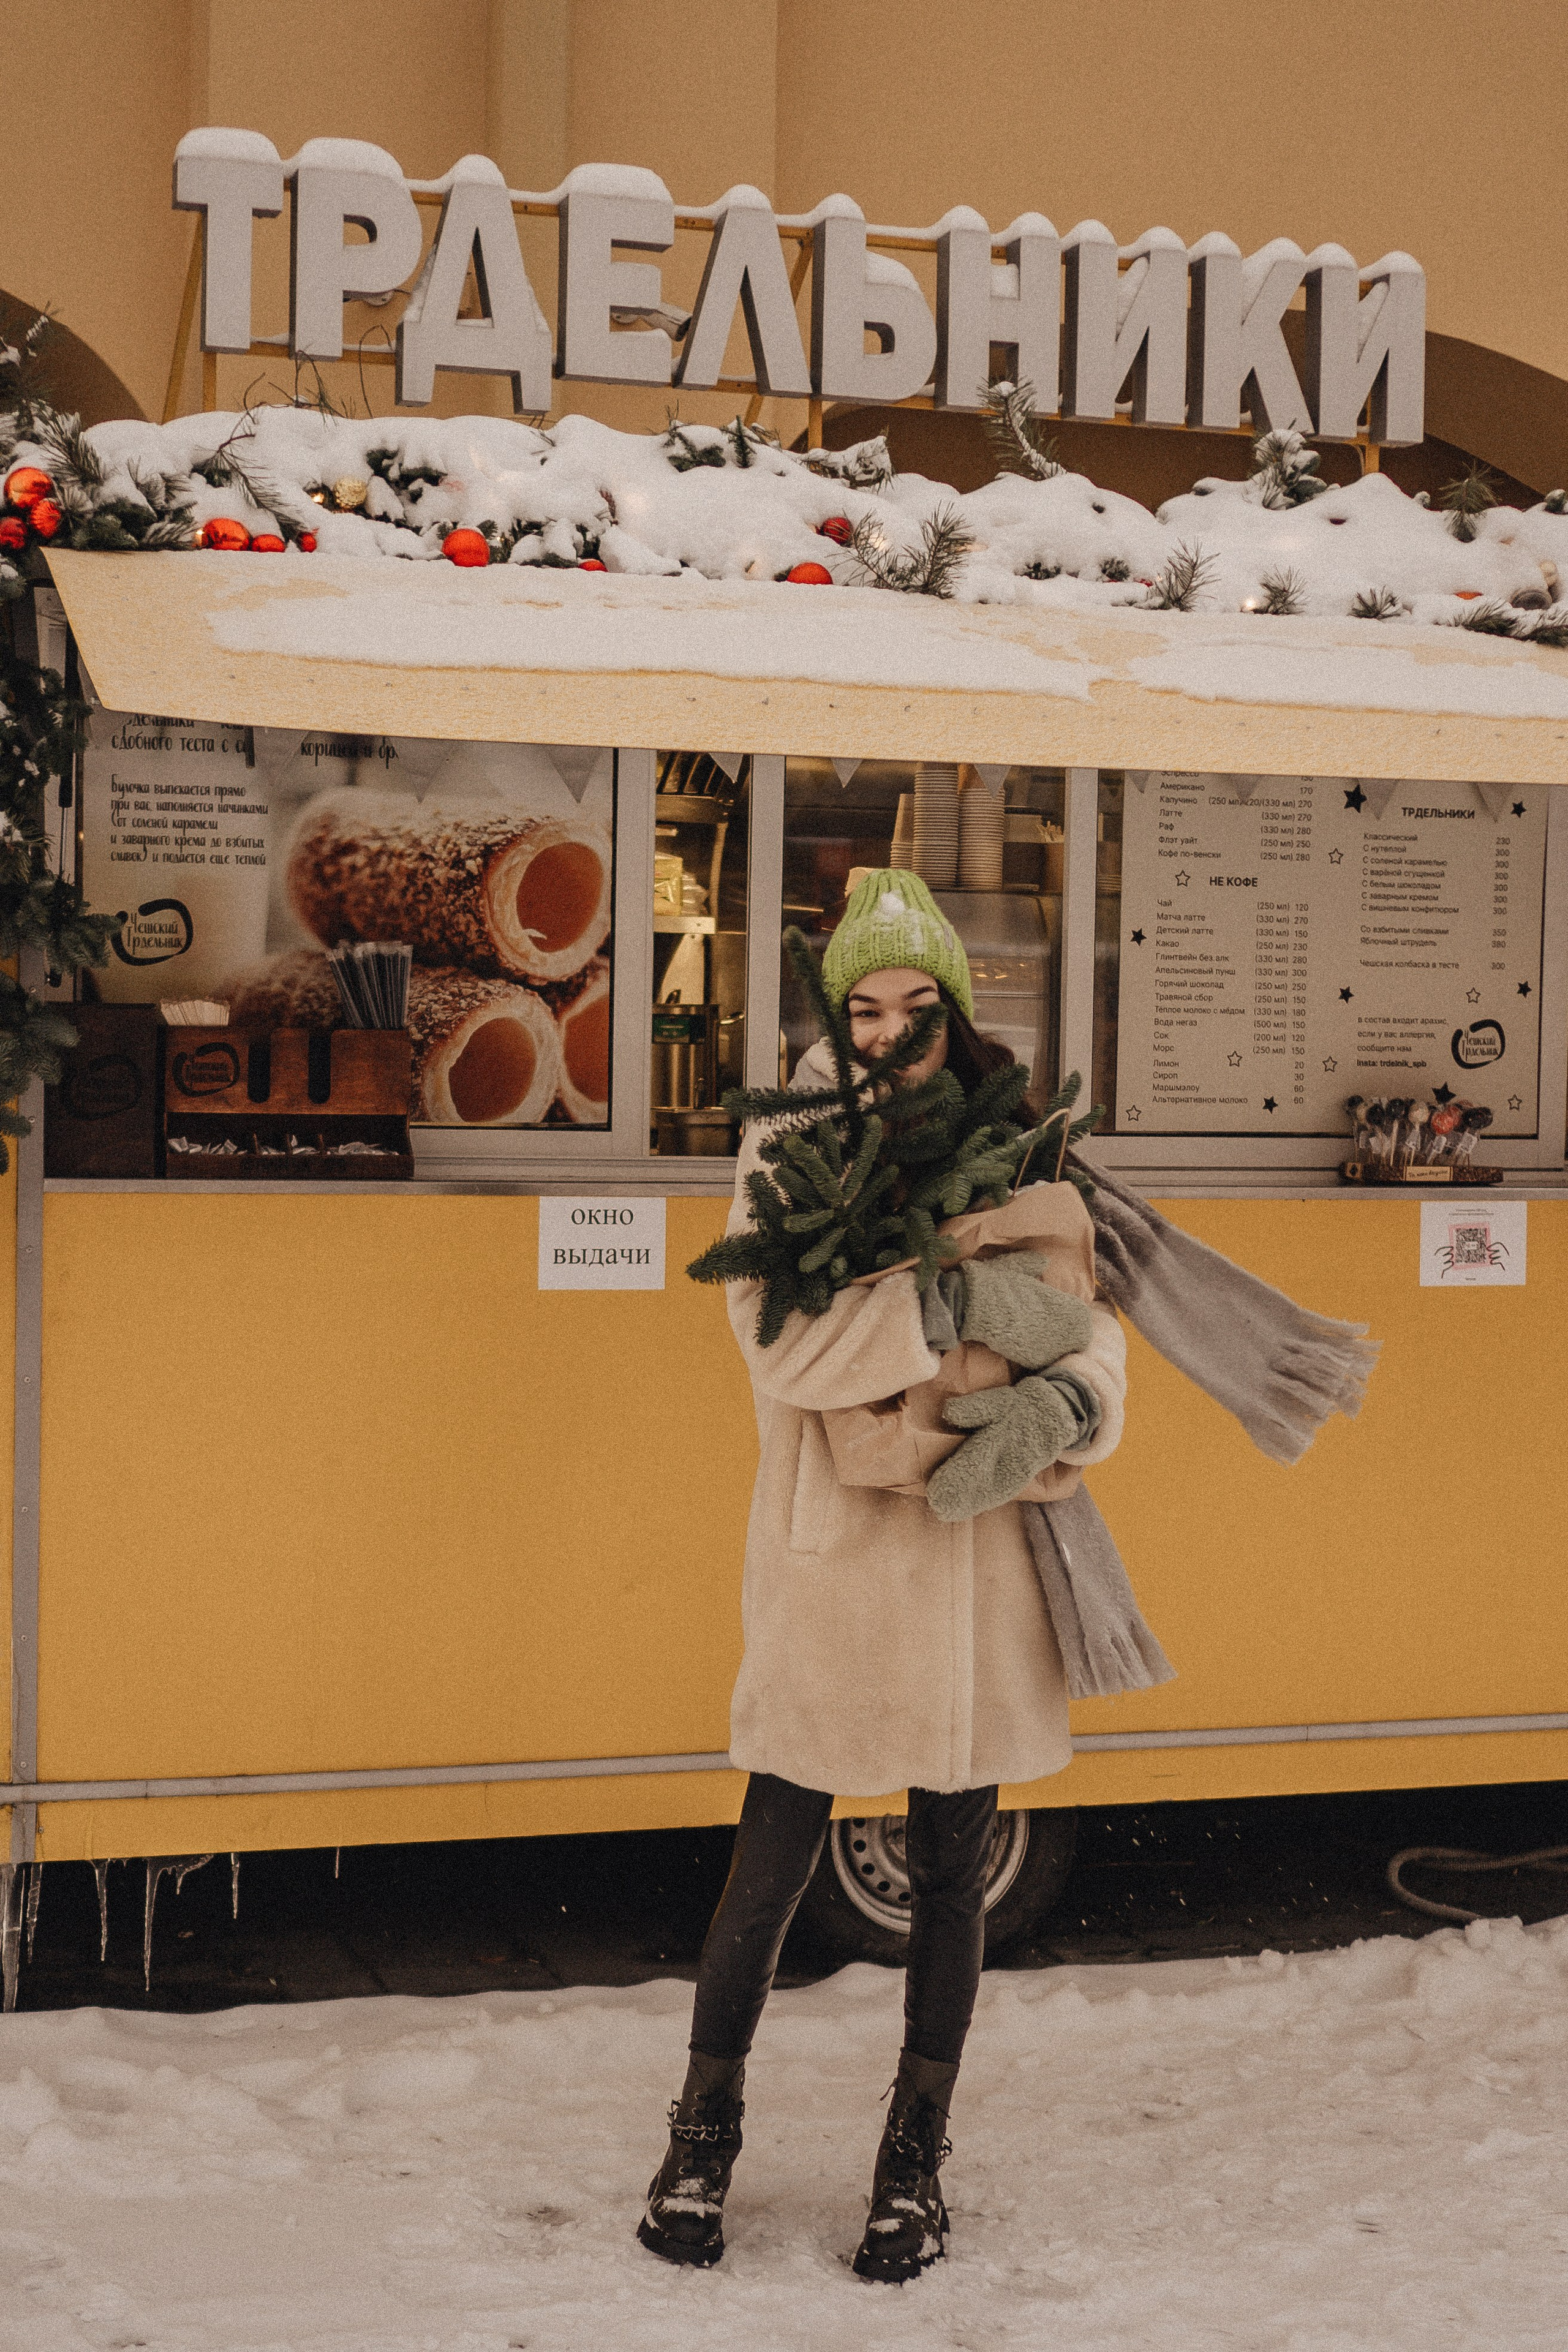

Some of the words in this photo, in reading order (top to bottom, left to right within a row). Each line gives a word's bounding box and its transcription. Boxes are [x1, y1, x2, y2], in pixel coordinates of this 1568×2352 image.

[175, 153, 1424, 448] ТРДЕЛЬНИКИ
[111, 725, 172, 750] сдобного
[179, 737, 214, 752] теста
[111, 774, 149, 799] Булочка
[154, 784, 210, 796] выпекается
[214, 786, 246, 803] прямо
[1160, 782, 1205, 791] Американо
[111, 800, 129, 816] при
[156, 802, 213, 813] наполняется
[217, 803, 268, 815] начинками
[1159, 796, 1197, 805] Капучино
[1208, 797, 1226, 805] (250
[1297, 799, 1313, 808] 270
[1159, 809, 1183, 818] Латте
[1262, 812, 1279, 821] (330
[1281, 812, 1295, 821] мл)
[1297, 813, 1313, 821] 270
[1401, 807, 1476, 820] ТРДЕЛЬНИКИ
[132, 816, 167, 828] соленой
[173, 819, 218, 835] карамели
[1158, 822, 1174, 831] Раф
[1261, 826, 1278, 835] (330
[1281, 827, 1294, 835] мл)
[121, 834, 170, 850] заварного
[175, 836, 205, 853] крема
[210, 837, 221, 847] до
[225, 834, 264, 848] взбитых
[1158, 835, 1178, 844] Флэт
[1180, 837, 1198, 846] уайт
[1261, 839, 1278, 848] (250
[1280, 840, 1294, 848] мл)
[1295, 840, 1311, 848] 250
[1363, 832, 1418, 842] Классический
[1495, 837, 1510, 845] 230
[1158, 849, 1178, 858] Кофе
[1260, 852, 1278, 861] (250
[1280, 853, 1293, 862] мл)
[1295, 853, 1311, 862] 280
[1494, 848, 1510, 857] 300
[152, 853, 158, 862] и
[209, 854, 230, 865] еще
[235, 853, 266, 865] теплой
[1494, 860, 1510, 869] 300
[1210, 876, 1224, 886] НЕ
[1226, 877, 1258, 887] КОФЕ
[1494, 872, 1509, 880] 300
[1493, 884, 1509, 892] 300
[1157, 899, 1172, 908] Чай
[1257, 902, 1275, 910] (250
[1276, 903, 1290, 911] мл)
[1493, 895, 1509, 904] 300
[1493, 907, 1508, 916] 300
[130, 913, 178, 934] Чешский
[1156, 913, 1182, 921] Матча
[1256, 915, 1274, 924] (330
[1276, 916, 1289, 925] мл)
[1294, 916, 1309, 925] 270
[1156, 925, 1189, 935] Детский
[1256, 928, 1274, 937] (330
[1275, 929, 1289, 938] мл)
[1294, 930, 1308, 938] 150
[1373, 925, 1410, 934] взбитыми
[126, 925, 183, 955] Трдельник
[1256, 941, 1273, 950] (250
[1275, 942, 1289, 951] мл)
[1292, 943, 1308, 951] 230
[1360, 937, 1399, 945] Яблочный
[1400, 939, 1438, 948] штрудель
[1155, 952, 1197, 962] Глинтвейн
[1255, 955, 1273, 963] (330
[1275, 956, 1289, 964] мл)
[1292, 956, 1308, 965] 280
[1359, 959, 1393, 968] Чешская
[1394, 960, 1430, 968] колбаска
[1155, 967, 1213, 975] Апельсиновый
[1255, 968, 1273, 976] (330
[1155, 979, 1188, 988] Горячий
[1254, 982, 1272, 990] (250
[1274, 982, 1288, 991] мл)
[1155, 993, 1193, 1002] Травяной
[1194, 993, 1213, 1002] сбор
[1254, 995, 1272, 1003] (250
[1273, 996, 1287, 1005] мл)
[1292, 996, 1306, 1005] 150
[1254, 1008, 1272, 1017] (330
[1273, 1009, 1287, 1017] мл)
[1154, 1018, 1174, 1027] Вода
[1253, 1020, 1272, 1029] (500
[1273, 1021, 1287, 1030] мл)
[1292, 1021, 1306, 1030] 150
[1153, 1031, 1169, 1040] Сок
[1253, 1033, 1272, 1042] (200
[1273, 1034, 1287, 1042] мл)
[1153, 1044, 1175, 1054] Морс
[1253, 1046, 1271, 1055] (250
[1272, 1047, 1286, 1055] мл)
[1291, 1047, 1305, 1055] 150
[1357, 1044, 1395, 1053] сообщите
[1153, 1071, 1178, 1080] Сироп
[1294, 1073, 1305, 1082] 30
[1152, 1084, 1200, 1093] Маршмэлоу
[1294, 1085, 1305, 1093] 60
[1152, 1096, 1217, 1104] Альтернативное
[1294, 1096, 1304, 1105] 60
[553, 1248, 651, 1268] выдачи
